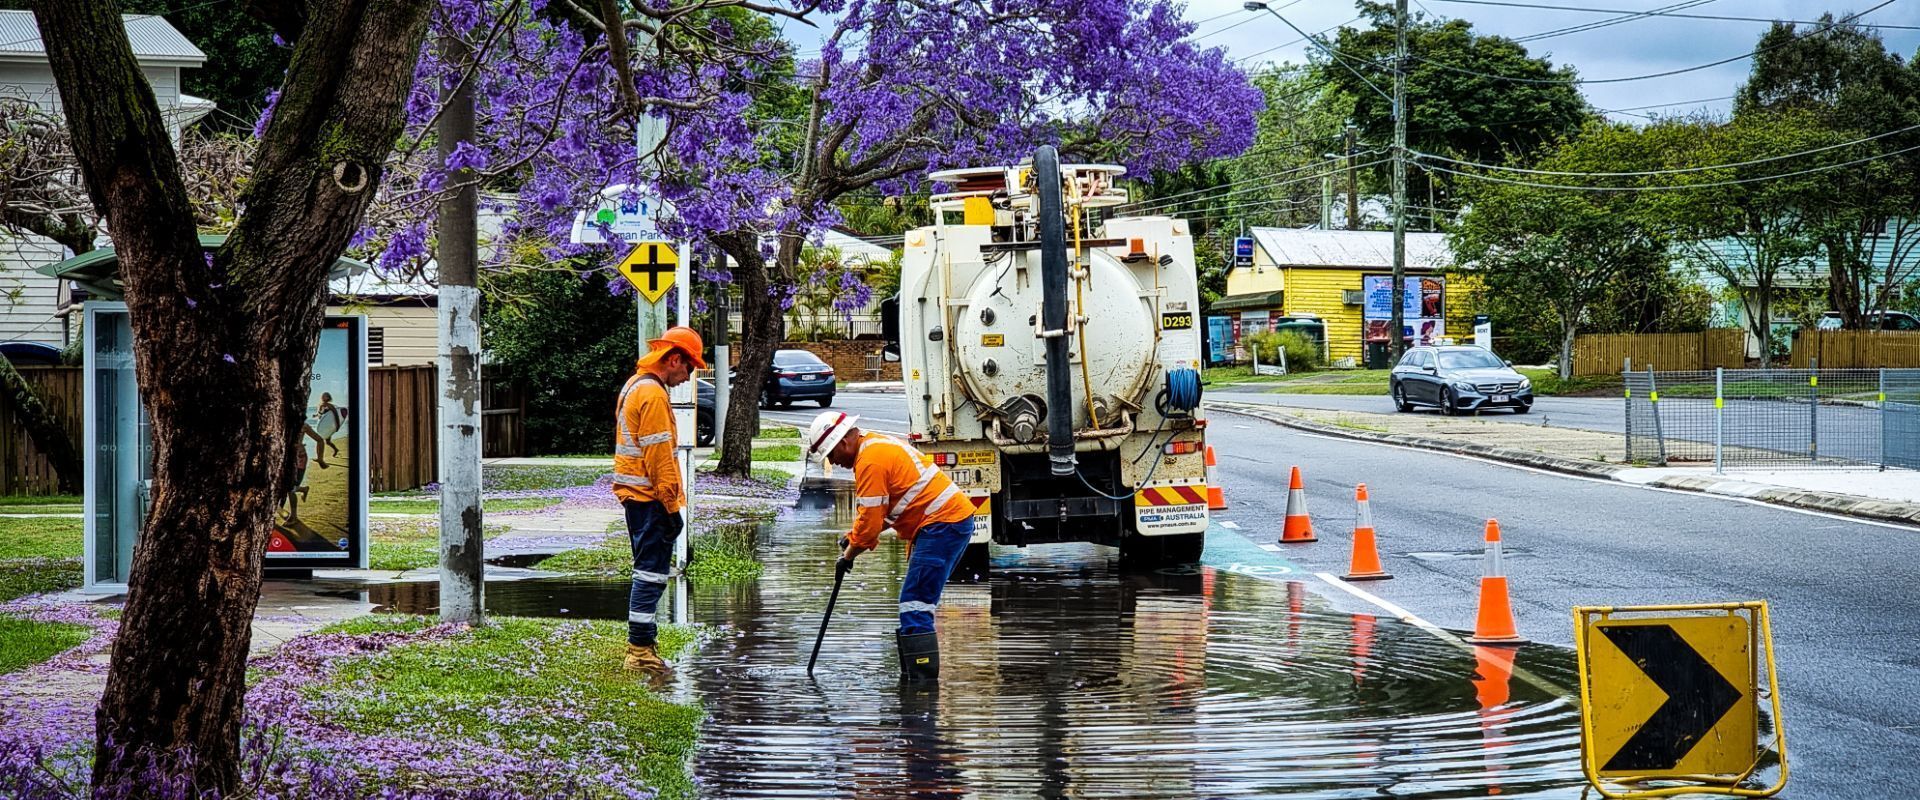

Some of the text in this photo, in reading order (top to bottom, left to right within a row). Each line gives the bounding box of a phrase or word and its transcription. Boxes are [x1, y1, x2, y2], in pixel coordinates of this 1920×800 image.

[640, 230, 662, 240] Park
[1164, 316, 1191, 327] D293
[1156, 505, 1204, 514] MANAGEMENT
[1165, 512, 1205, 521] AUSTRALIA
